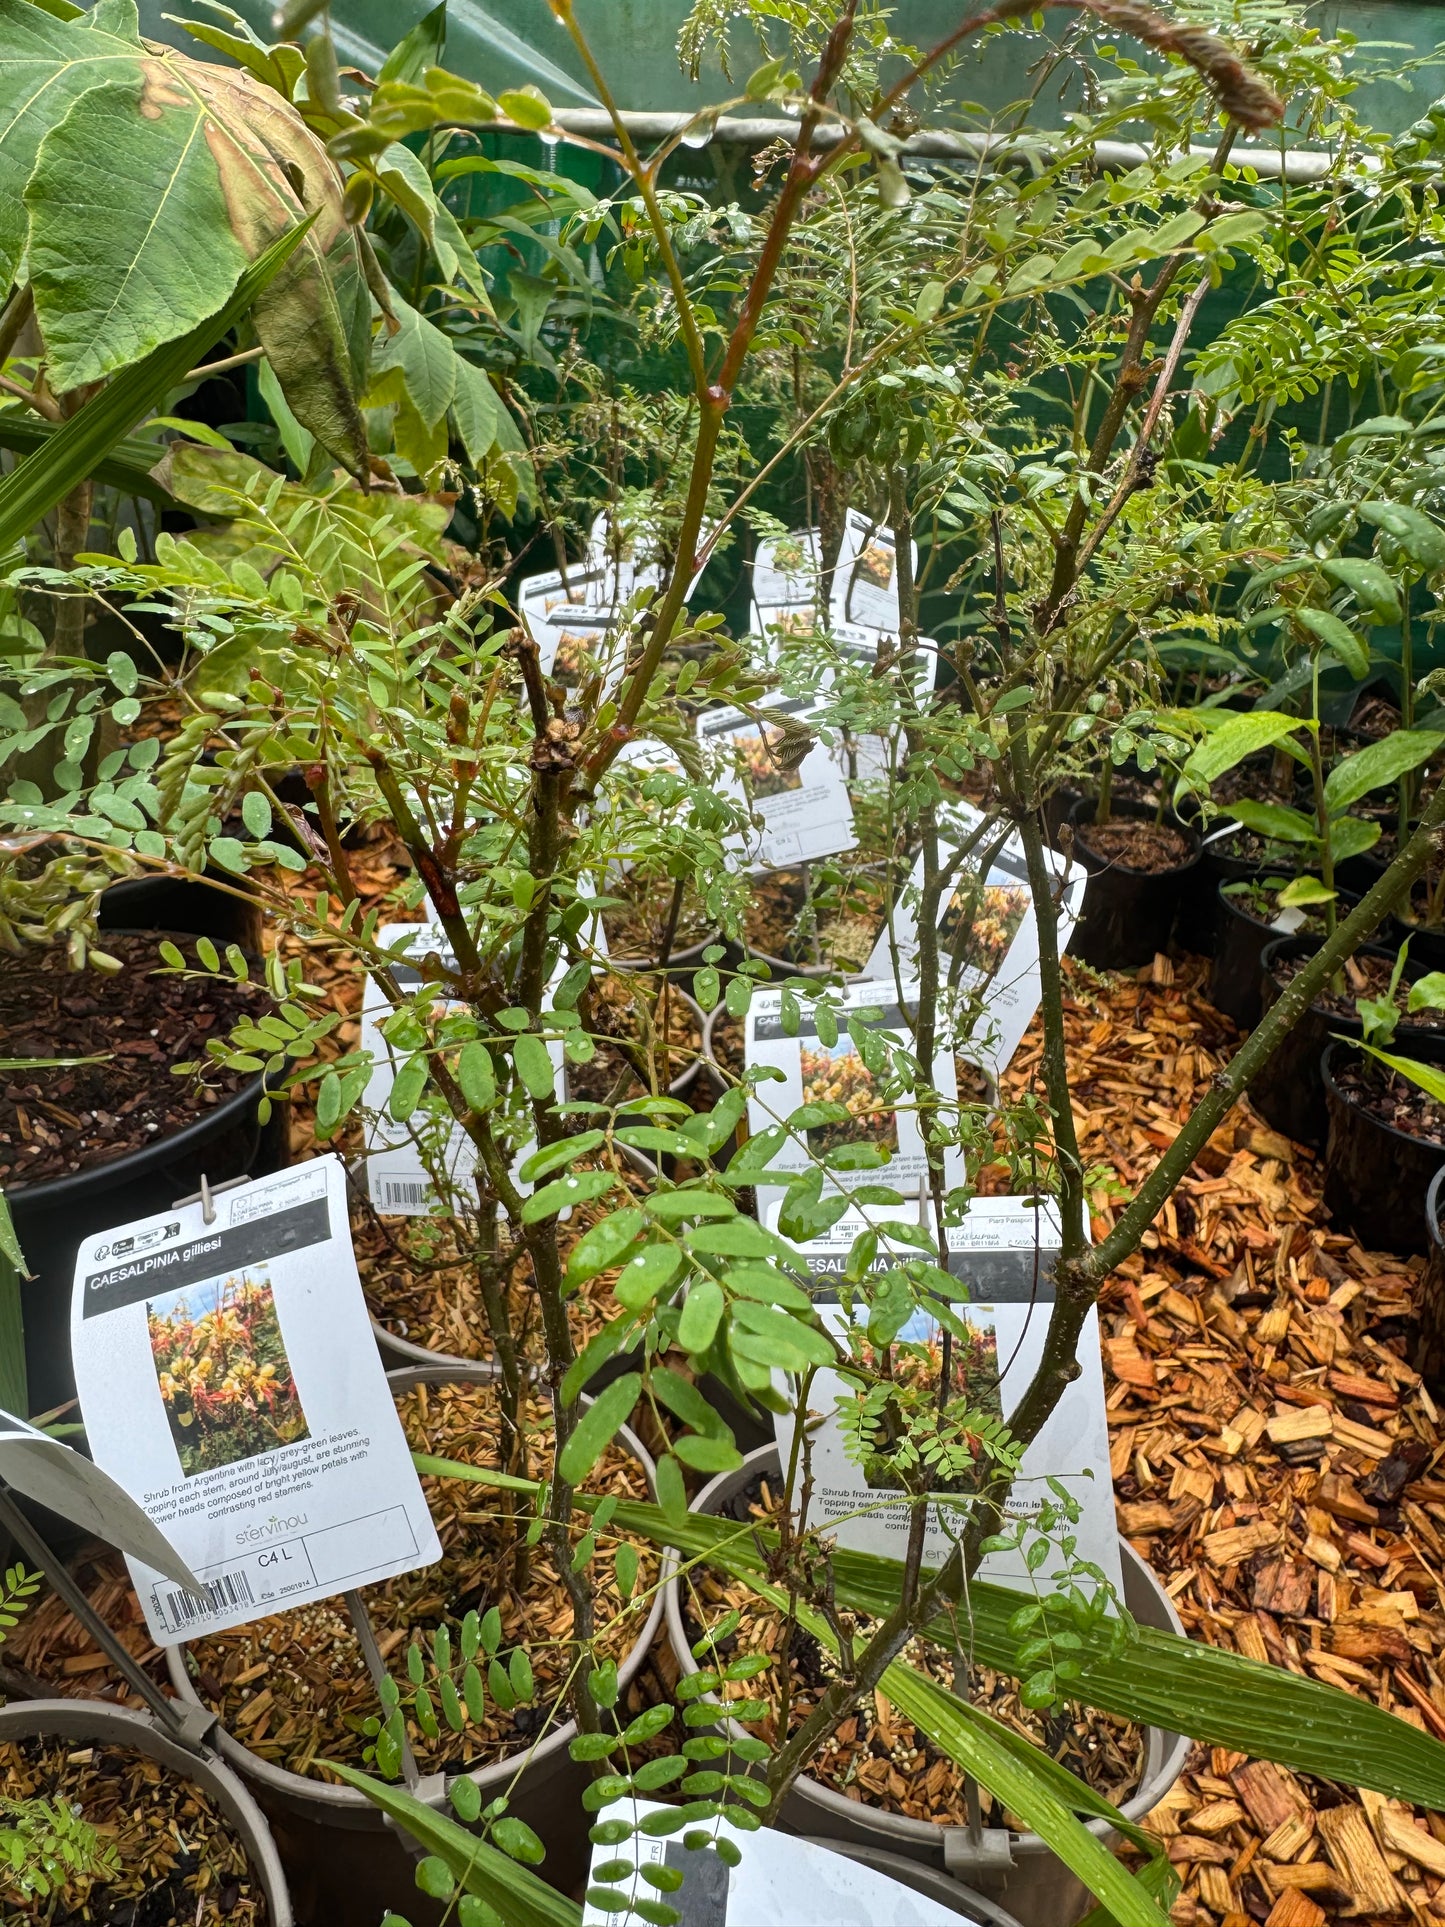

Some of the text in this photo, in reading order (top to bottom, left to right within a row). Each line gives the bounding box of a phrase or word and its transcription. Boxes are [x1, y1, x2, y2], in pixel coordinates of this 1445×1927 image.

[90, 1251, 180, 1290] CAESALPINIA
[183, 1236, 223, 1261] gilliesi
[143, 1488, 170, 1503] Shrub
[171, 1481, 192, 1495] from
[237, 1460, 256, 1473] with
[280, 1438, 328, 1461] grey-green
[178, 1503, 206, 1518] heads
[207, 1485, 253, 1508] composed
[254, 1482, 264, 1493] of
[265, 1474, 290, 1489] bright
[291, 1466, 320, 1483] yellow
[321, 1456, 348, 1473] petals
[349, 1450, 368, 1462] with
[179, 1490, 201, 1504] each
[203, 1483, 226, 1497] stem,
[229, 1471, 260, 1489] around
[316, 1449, 331, 1461] are
[333, 1437, 371, 1455] stunning
[208, 1480, 314, 1520] contrasting red stamens.
[818, 1497, 856, 1509] Topping
[821, 1488, 850, 1498] Shrub
[852, 1490, 874, 1499] from
[236, 1513, 309, 1545] stervinou
[258, 1548, 293, 1568] C4 L
